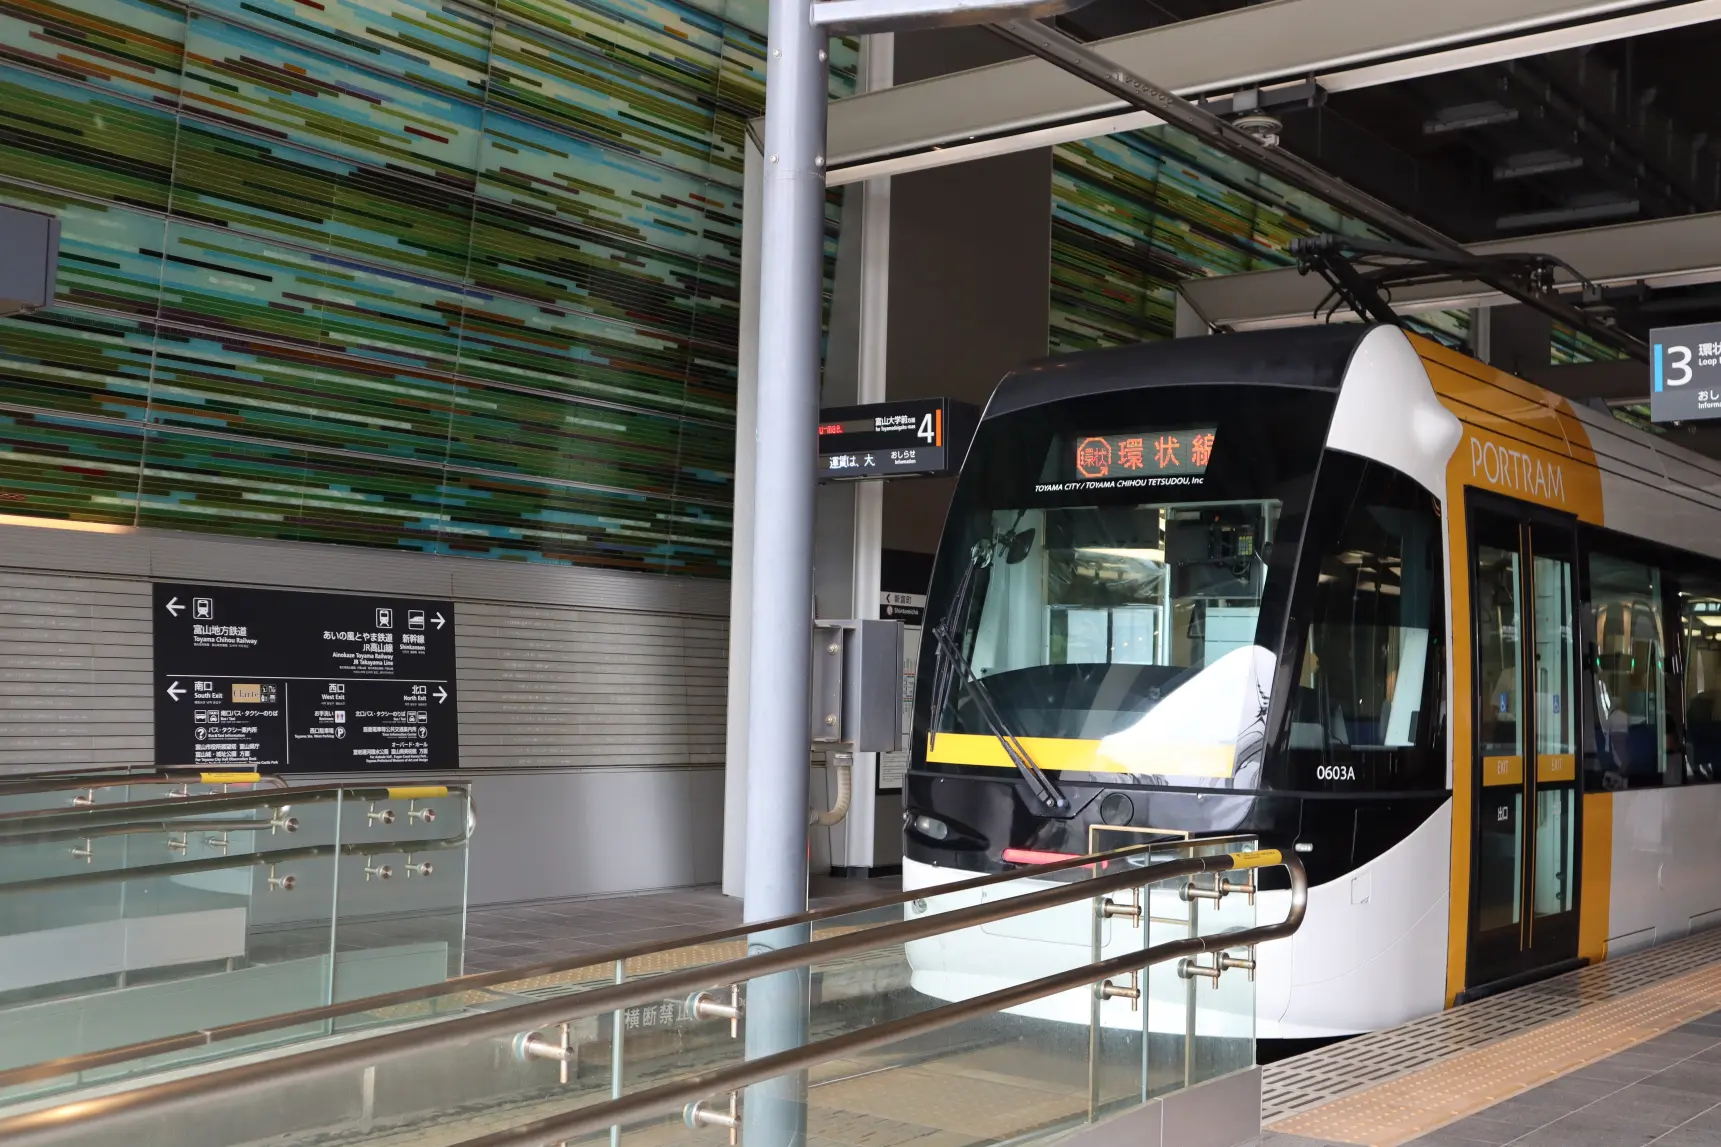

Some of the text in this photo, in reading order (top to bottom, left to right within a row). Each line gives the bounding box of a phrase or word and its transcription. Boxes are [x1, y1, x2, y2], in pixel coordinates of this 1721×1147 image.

[1667, 345, 1693, 387] 3
[1698, 358, 1718, 367] Loop
[1698, 390, 1720, 401] おし
[1698, 401, 1721, 409] Inform
[917, 413, 935, 443] 4
[890, 449, 916, 459] おしらせ
[1470, 436, 1565, 504] PORTRAM
[1034, 483, 1063, 493] TOYAMA
[1086, 480, 1115, 490] TOYAMA
[1116, 479, 1148, 488] CHIHOU
[1148, 476, 1191, 486] TETSUDOU,
[1191, 476, 1205, 485] Inc
[193, 624, 247, 637] 富山地方鉄道
[194, 636, 215, 644] Toyama
[236, 637, 258, 646] Railway
[323, 631, 394, 643] あいの風とやま鉄道
[402, 633, 425, 644] 新幹線
[362, 642, 394, 653] JR高山線
[356, 652, 375, 660] Toyama
[375, 653, 394, 661] Railway
[360, 659, 383, 667] Takayama
[194, 681, 213, 692] 南口
[328, 683, 345, 693] 西口
[411, 684, 427, 695] 北口
[1316, 765, 1356, 781] 0603A
[1497, 760, 1508, 775] EXIT
[1497, 806, 1509, 821] 出口
